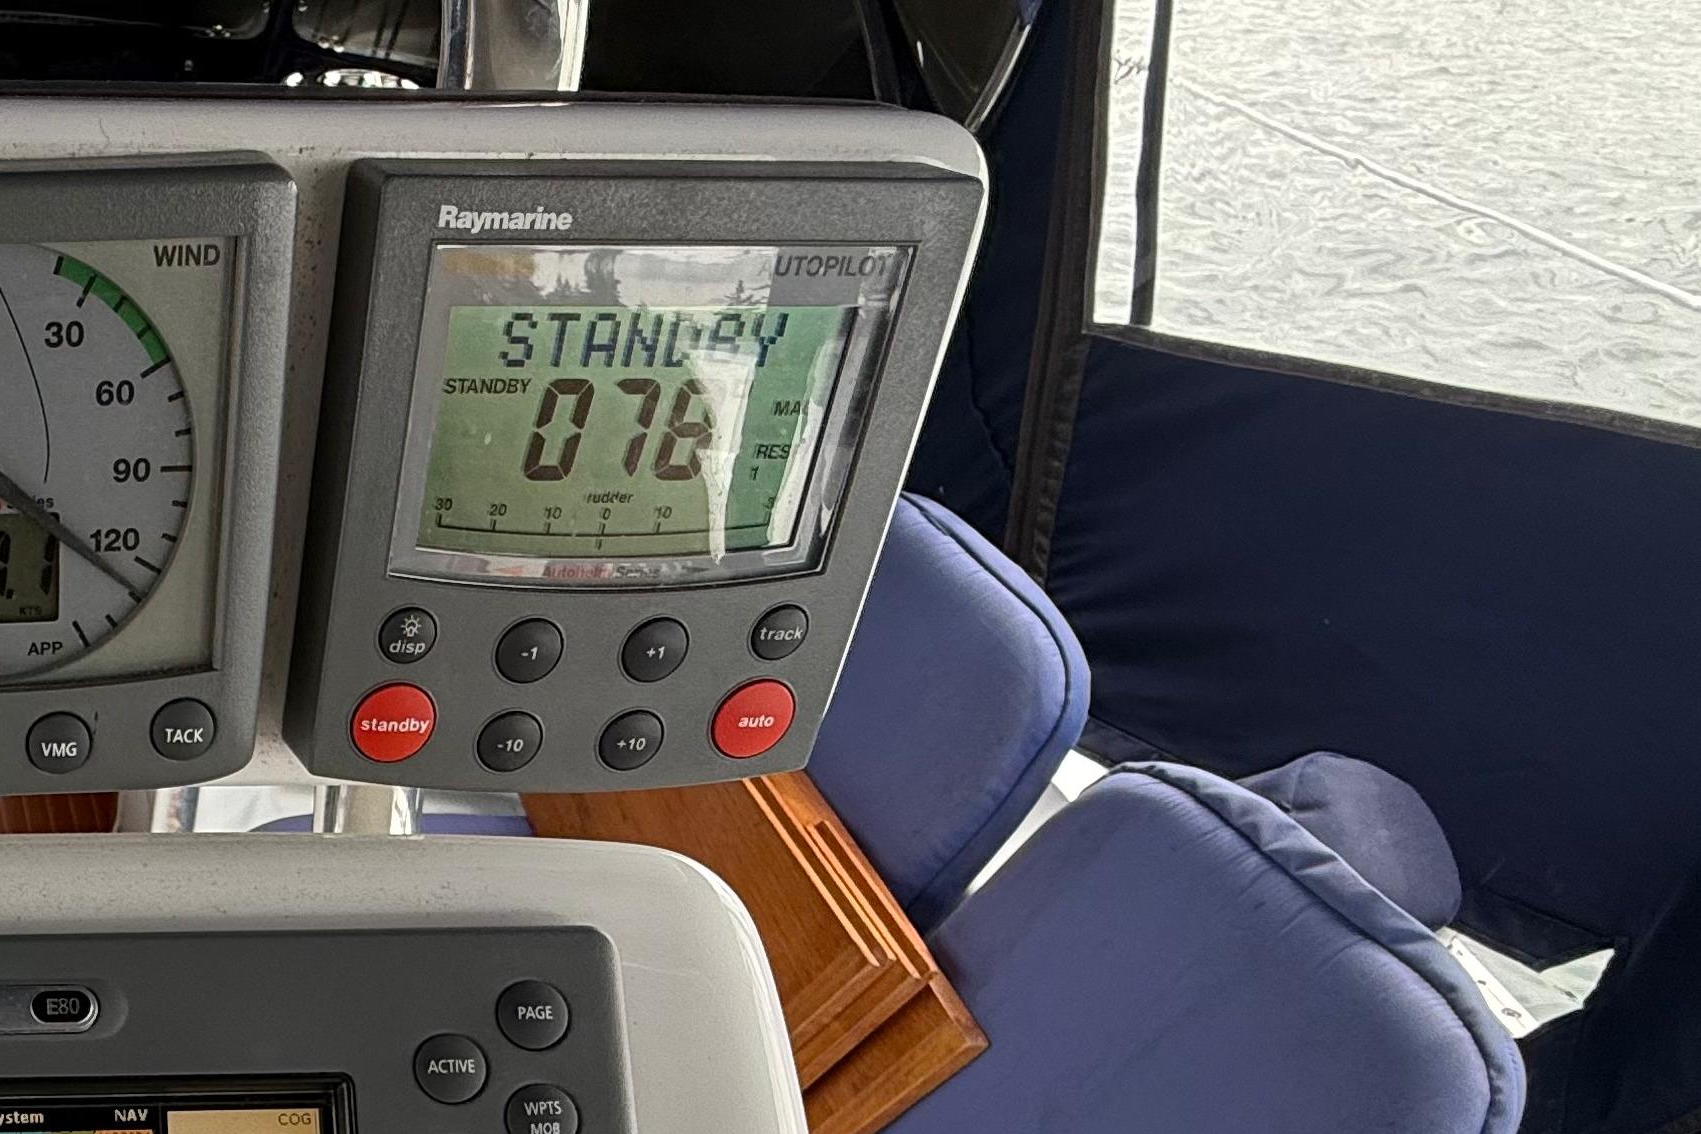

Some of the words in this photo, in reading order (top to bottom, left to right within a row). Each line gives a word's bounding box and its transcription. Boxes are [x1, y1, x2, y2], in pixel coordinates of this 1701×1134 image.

[438, 204, 573, 235] Raymarine
[153, 243, 221, 268] WIND
[43, 321, 85, 348] 30
[94, 380, 135, 406] 60
[443, 377, 533, 396] STANDBY
[112, 457, 152, 483] 90
[434, 498, 453, 511] 30
[586, 491, 634, 504] rudder
[489, 503, 507, 517] 20
[656, 505, 672, 520] 10
[89, 526, 141, 554] 120
[760, 626, 803, 642] track
[27, 641, 64, 658] APP
[389, 638, 427, 656] disp
[520, 646, 539, 661] -1
[645, 645, 666, 661] +1
[360, 716, 430, 735] standby
[738, 714, 775, 729] auto
[164, 727, 205, 745] TACK
[616, 736, 647, 752] +10
[40, 741, 79, 759] VMG
[496, 737, 524, 753] -10
[45, 997, 80, 1016] E80
[517, 1004, 554, 1021] PAGE
[427, 1058, 476, 1074] ACTIVE
[114, 1108, 149, 1123] NAV
[523, 1100, 563, 1116] WPTS
[277, 1112, 312, 1126] COG
